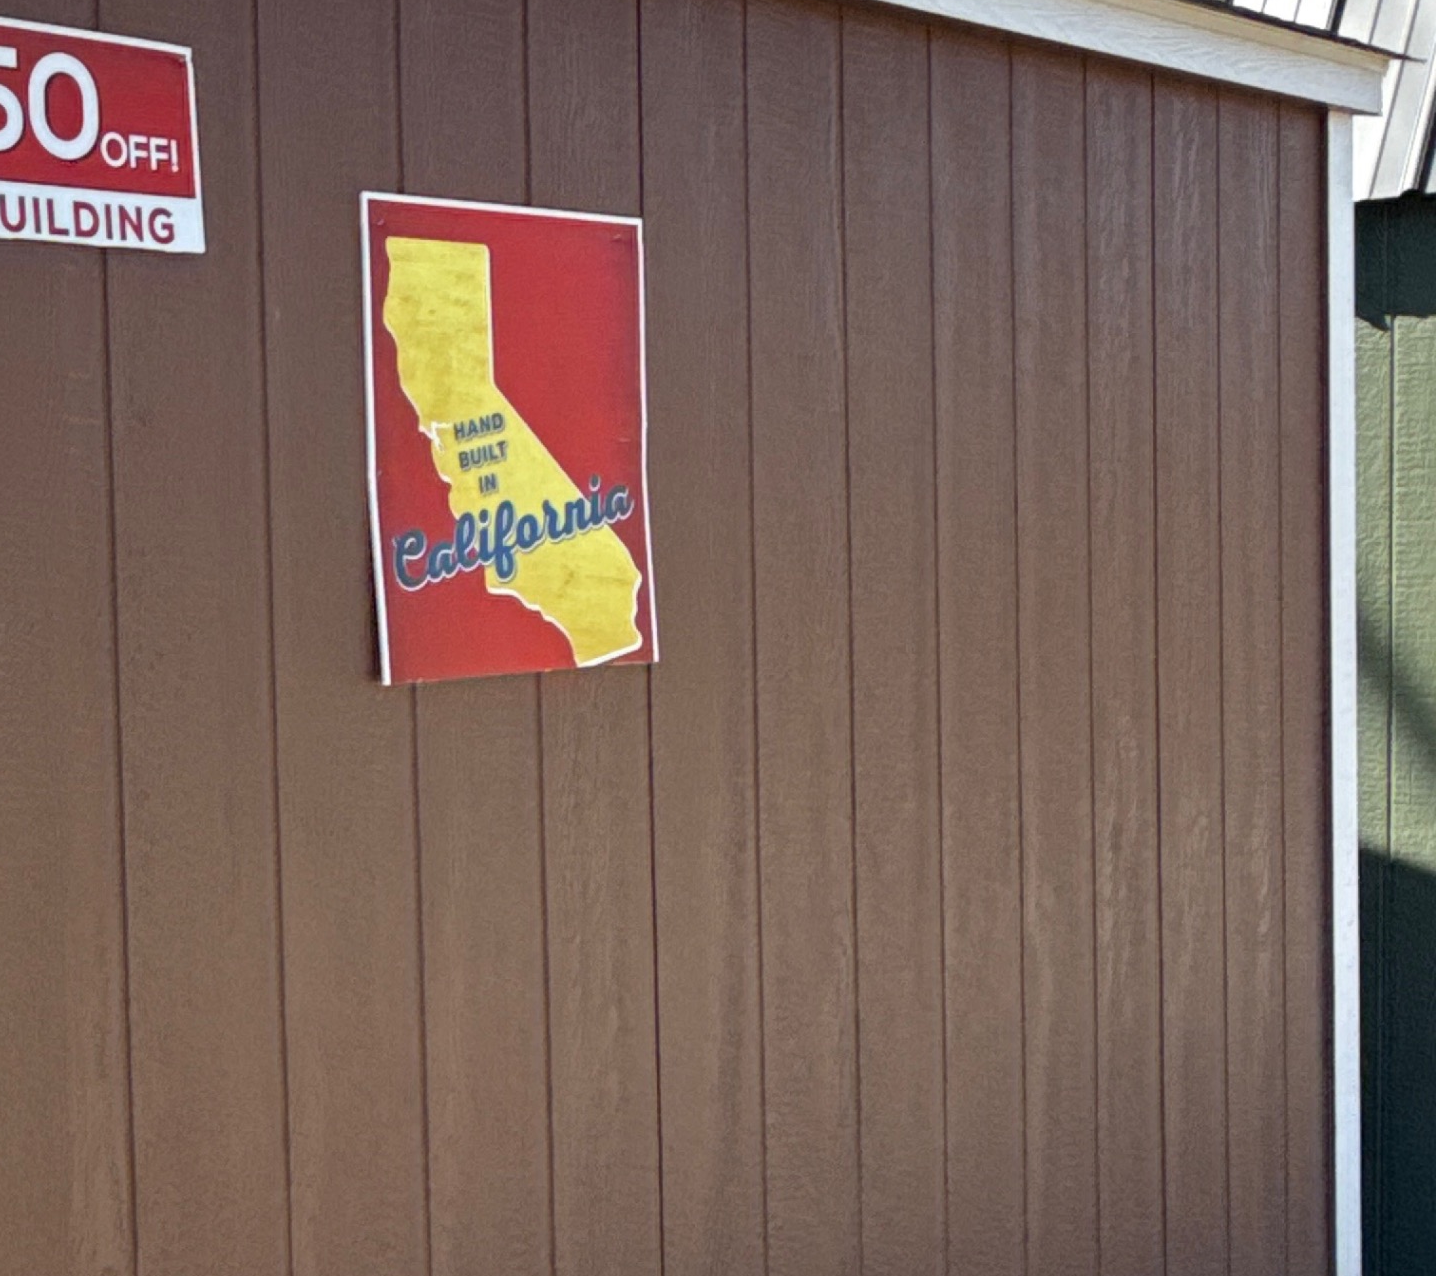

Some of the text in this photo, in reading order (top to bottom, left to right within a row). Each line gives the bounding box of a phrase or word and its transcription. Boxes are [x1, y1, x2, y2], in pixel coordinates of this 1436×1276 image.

[99, 131, 180, 173] OFF!
[453, 412, 505, 440] HAND
[458, 440, 508, 470] BUILT
[478, 473, 498, 495] IN
[392, 474, 634, 591] California
